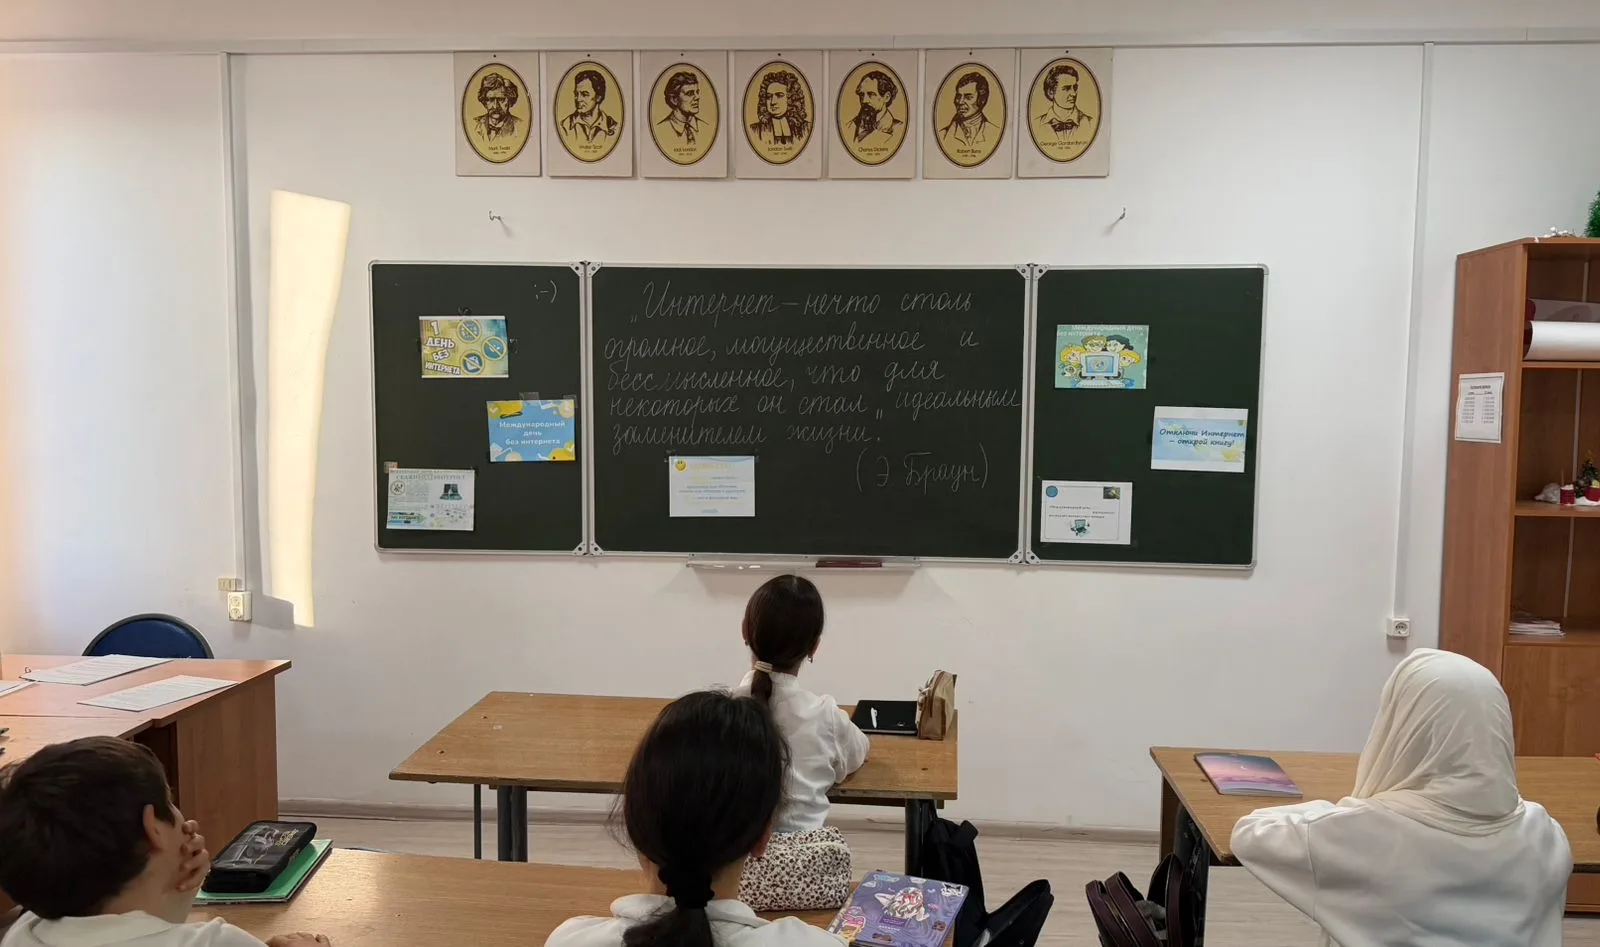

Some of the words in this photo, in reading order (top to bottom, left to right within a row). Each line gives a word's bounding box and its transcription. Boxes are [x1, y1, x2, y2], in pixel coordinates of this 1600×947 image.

[803, 293, 881, 316] нечто
[900, 291, 973, 312] столь
[426, 337, 455, 349] ДЕНЬ
[604, 335, 717, 372] огромное,
[726, 320, 926, 367] могущественное
[959, 330, 980, 348] и
[425, 361, 461, 375] ИНТЕРНЕТА
[807, 364, 862, 385] что
[883, 359, 946, 392] для
[609, 394, 741, 428] некоторых
[756, 394, 788, 415] он
[797, 393, 868, 416] стал
[498, 421, 566, 429] Международный
[1159, 428, 1198, 437] Отключи
[1201, 430, 1245, 440] Интернет
[611, 422, 768, 456] заменителем
[786, 424, 881, 455] жизни.
[1177, 439, 1208, 448] открой
[903, 442, 988, 495] Браун)
